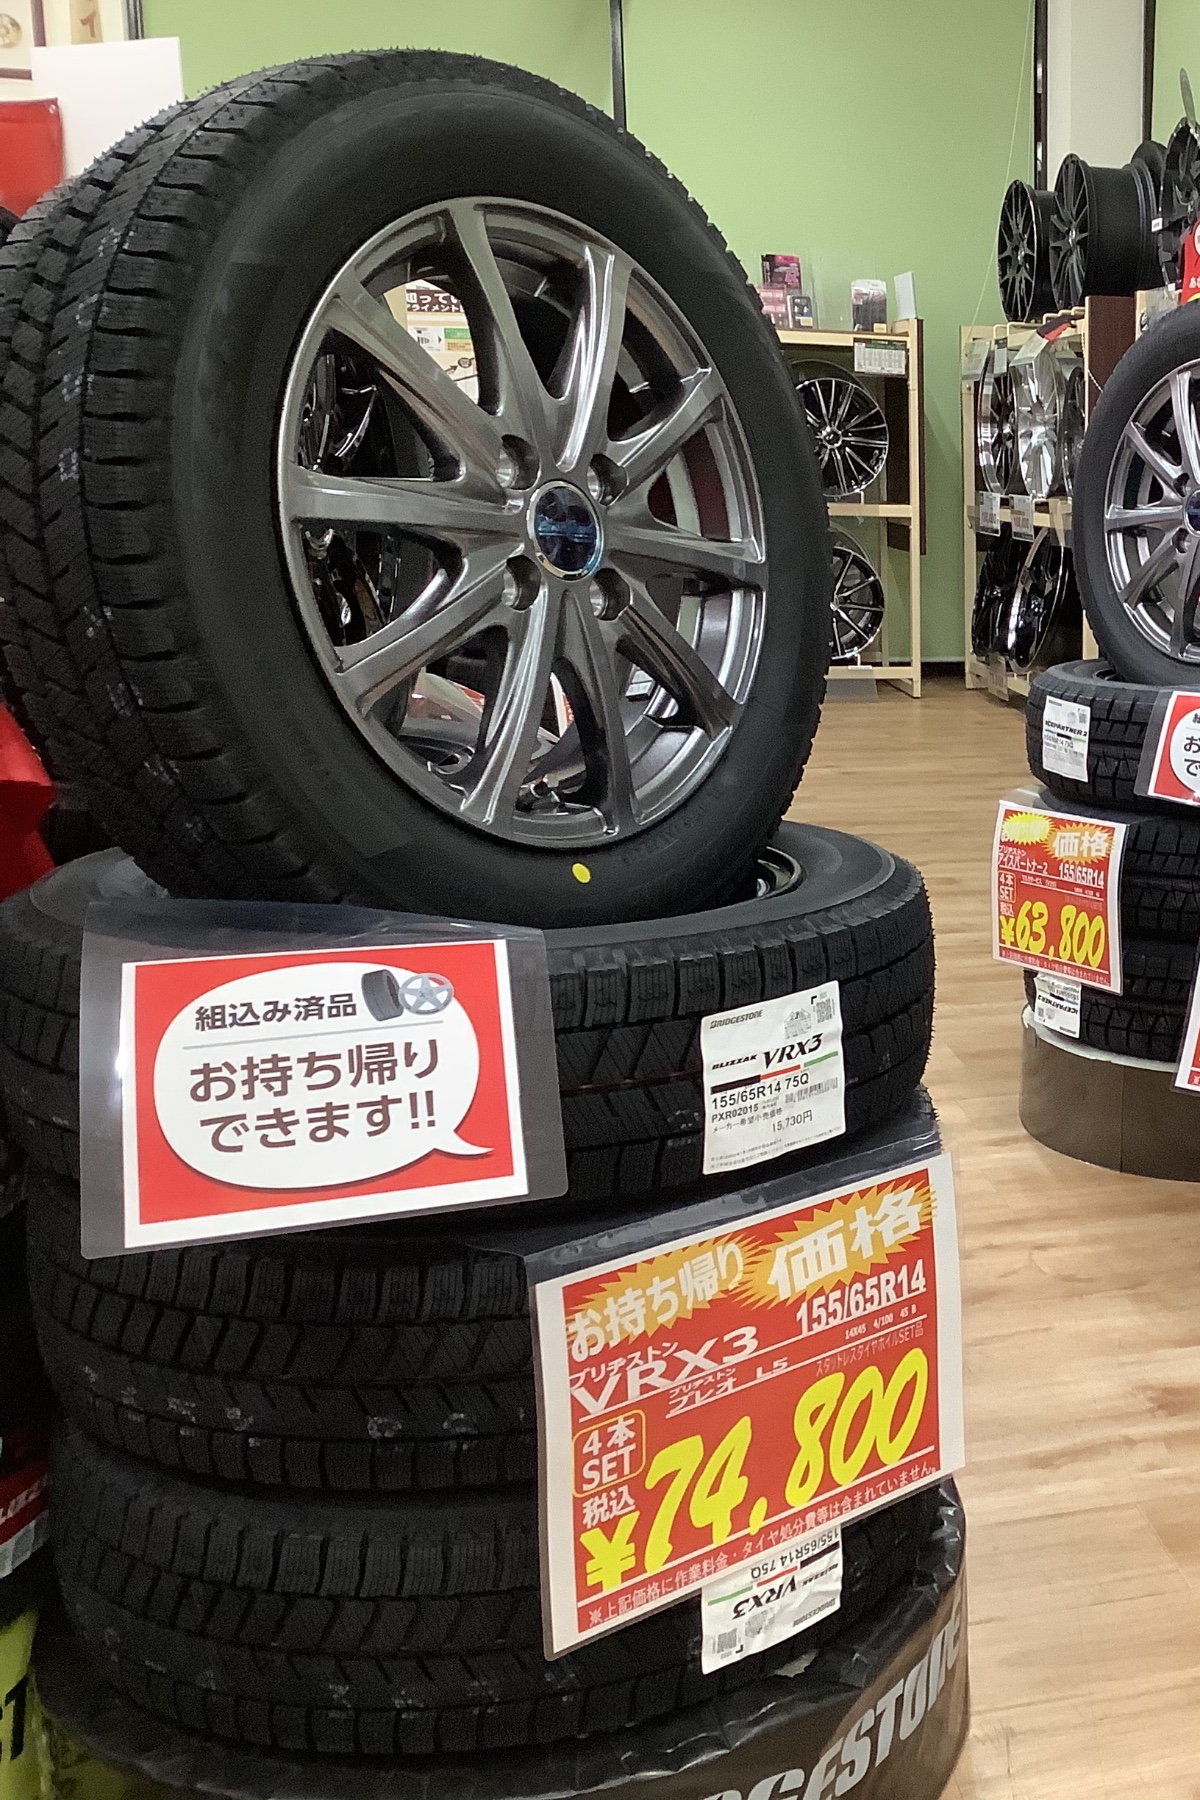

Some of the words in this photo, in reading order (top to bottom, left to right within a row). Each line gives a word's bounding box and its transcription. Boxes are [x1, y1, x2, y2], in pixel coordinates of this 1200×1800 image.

[1053, 831, 1109, 858] 価格
[999, 873, 1014, 886] 4本
[999, 885, 1014, 900] SET
[1059, 862, 1105, 887] 155/65R14
[195, 993, 358, 1032] 組込み済品
[709, 1009, 764, 1029] BRIDGESTONE
[190, 1039, 439, 1103] お持ち帰り
[711, 1054, 758, 1071] BLIZZAK
[762, 1033, 824, 1070] VRX3
[711, 1084, 782, 1110] 155/65R14
[785, 1072, 810, 1091] 75Q
[711, 1103, 759, 1124] PXR02015
[712, 1108, 783, 1134] メーカー希望小売価格
[771, 1109, 814, 1133] 15,730円
[768, 1187, 923, 1301] 価格
[570, 1243, 747, 1362] お持ち帰り
[796, 1258, 926, 1337] 155/65R14
[873, 1312, 894, 1330] 4/100
[900, 1306, 909, 1318] 45
[570, 1325, 758, 1415] VRX3
[668, 1378, 737, 1414] プレオ
[756, 1357, 789, 1380] L5
[582, 1416, 637, 1456] 4本
[582, 1446, 634, 1492] SET
[582, 1488, 636, 1529] 税込
[780, 1526, 840, 1566] 155/65R14
[751, 1560, 777, 1580] 75Q
[732, 1576, 798, 1620] VRX3
[703, 1602, 963, 1800] ESTONE
